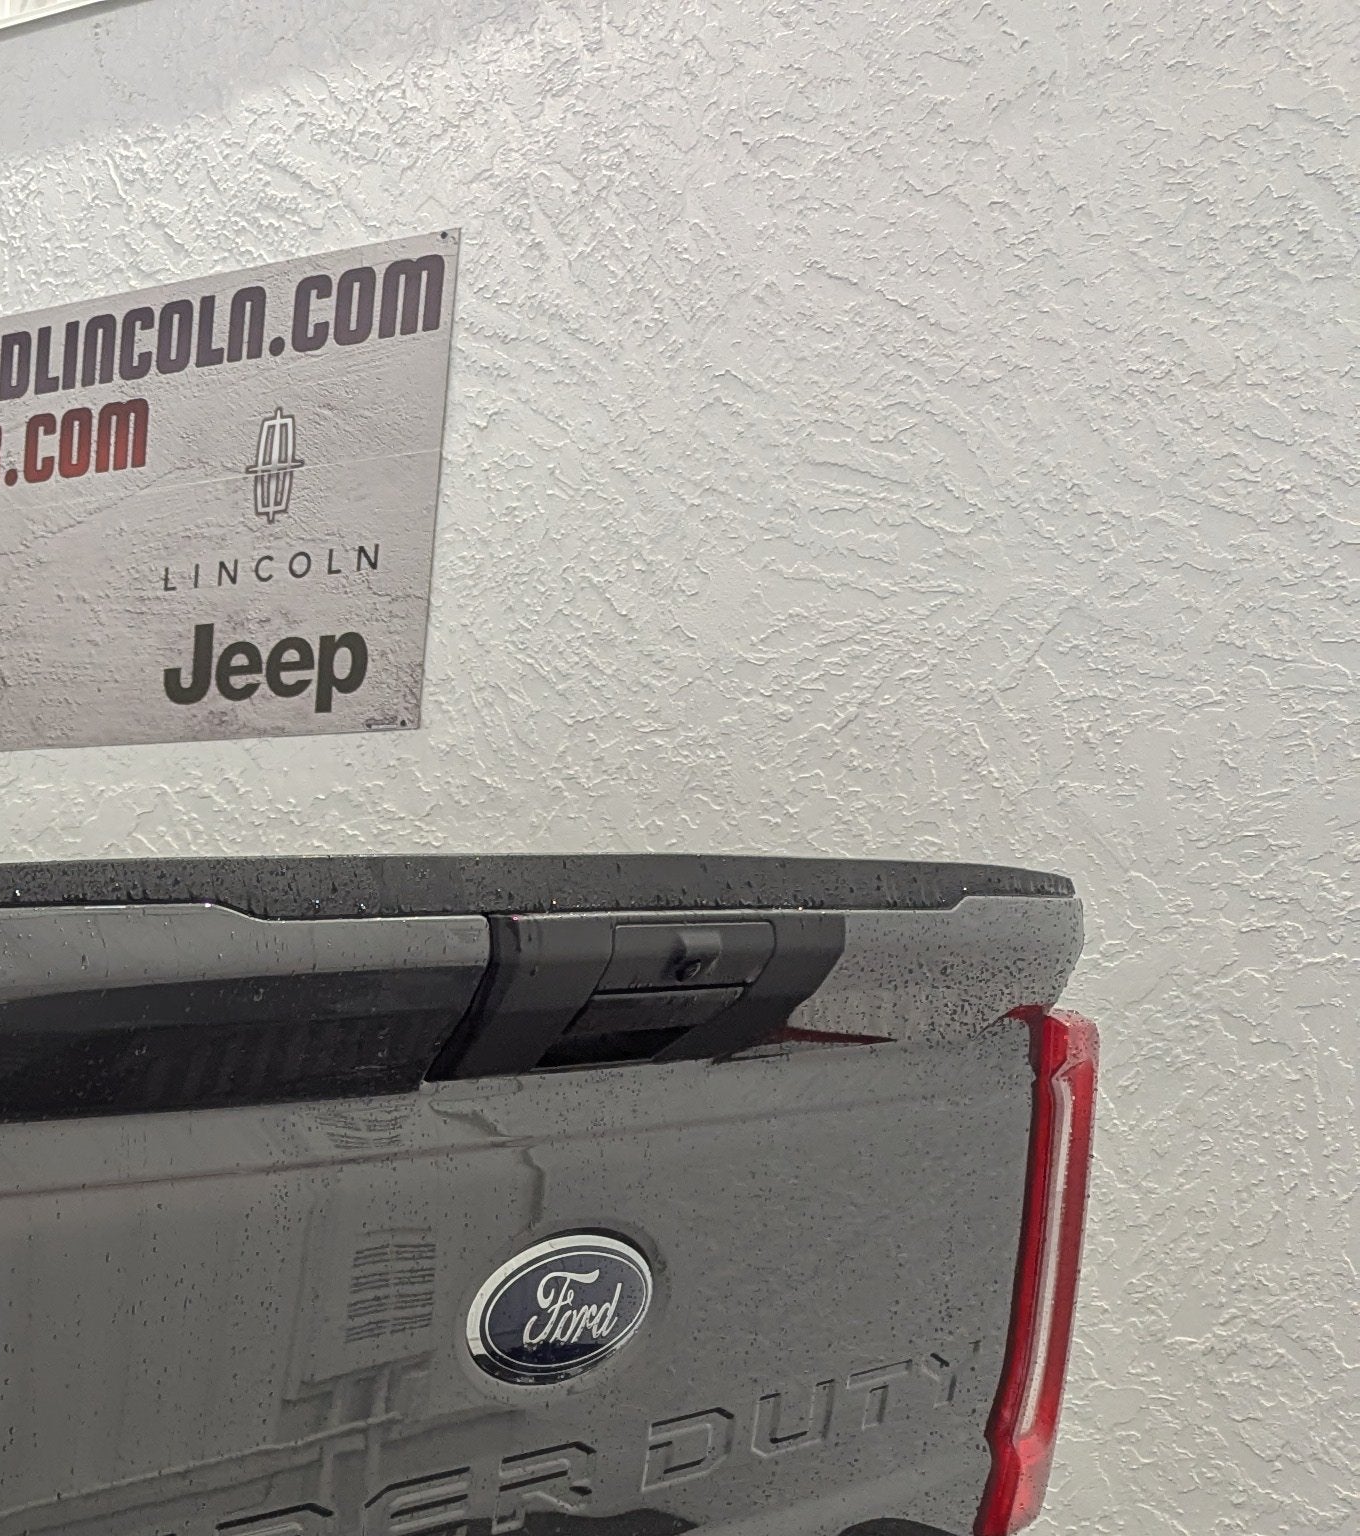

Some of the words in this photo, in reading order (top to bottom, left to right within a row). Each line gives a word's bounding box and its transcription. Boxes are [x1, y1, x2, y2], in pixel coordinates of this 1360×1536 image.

[163, 543, 380, 592] LINCOLN
[163, 622, 368, 714] Jeep
[522, 1269, 623, 1349] Ford
